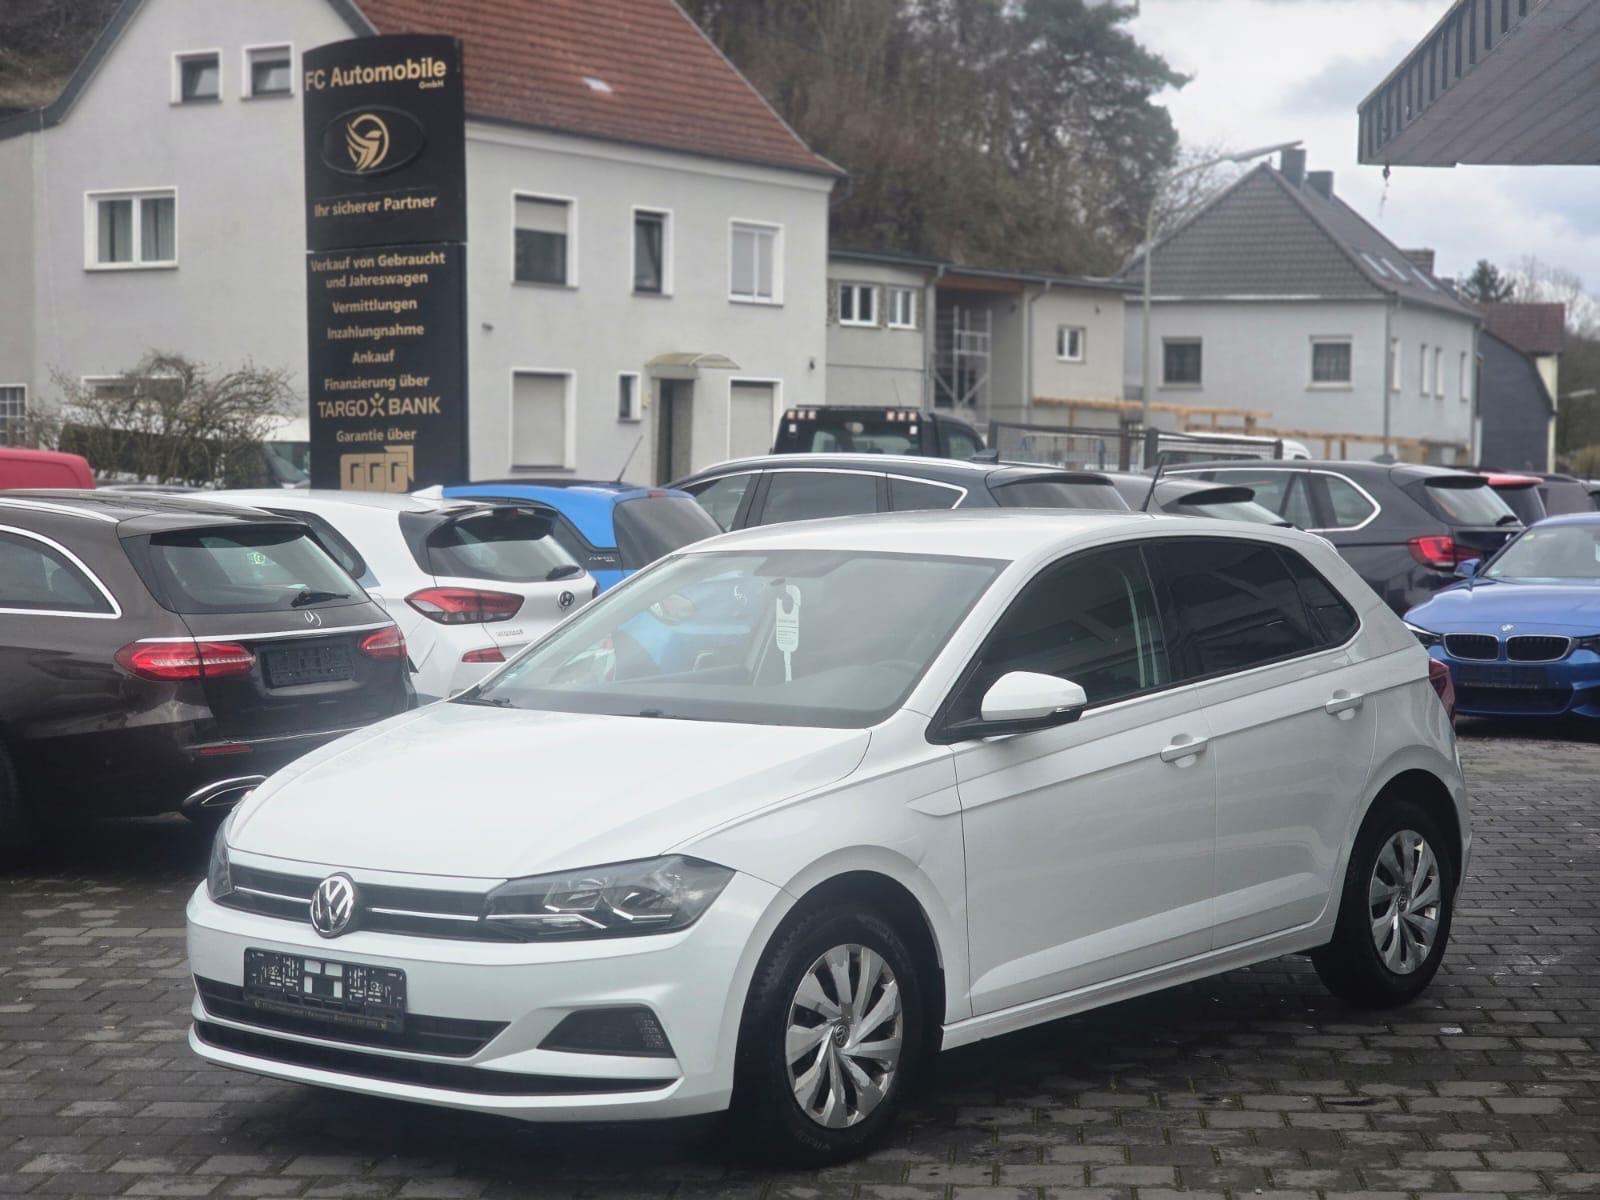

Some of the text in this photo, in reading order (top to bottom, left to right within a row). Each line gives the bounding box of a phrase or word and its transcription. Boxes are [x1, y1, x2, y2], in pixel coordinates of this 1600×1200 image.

[305, 57, 447, 91] FC Automobile
[418, 79, 445, 89] GmbH
[314, 196, 437, 217] Ihr sicherer Partner
[311, 252, 446, 272] Verkauf von Gebraucht
[326, 271, 428, 288] und Jahreswagen
[332, 299, 417, 316] Vermittlungen
[327, 324, 424, 340] Inzahlungnahme
[352, 349, 395, 364] Ankauf
[324, 374, 429, 391] Finanzierung über
[317, 396, 440, 418] TARGO BANK
[336, 428, 416, 443] Garantie über
